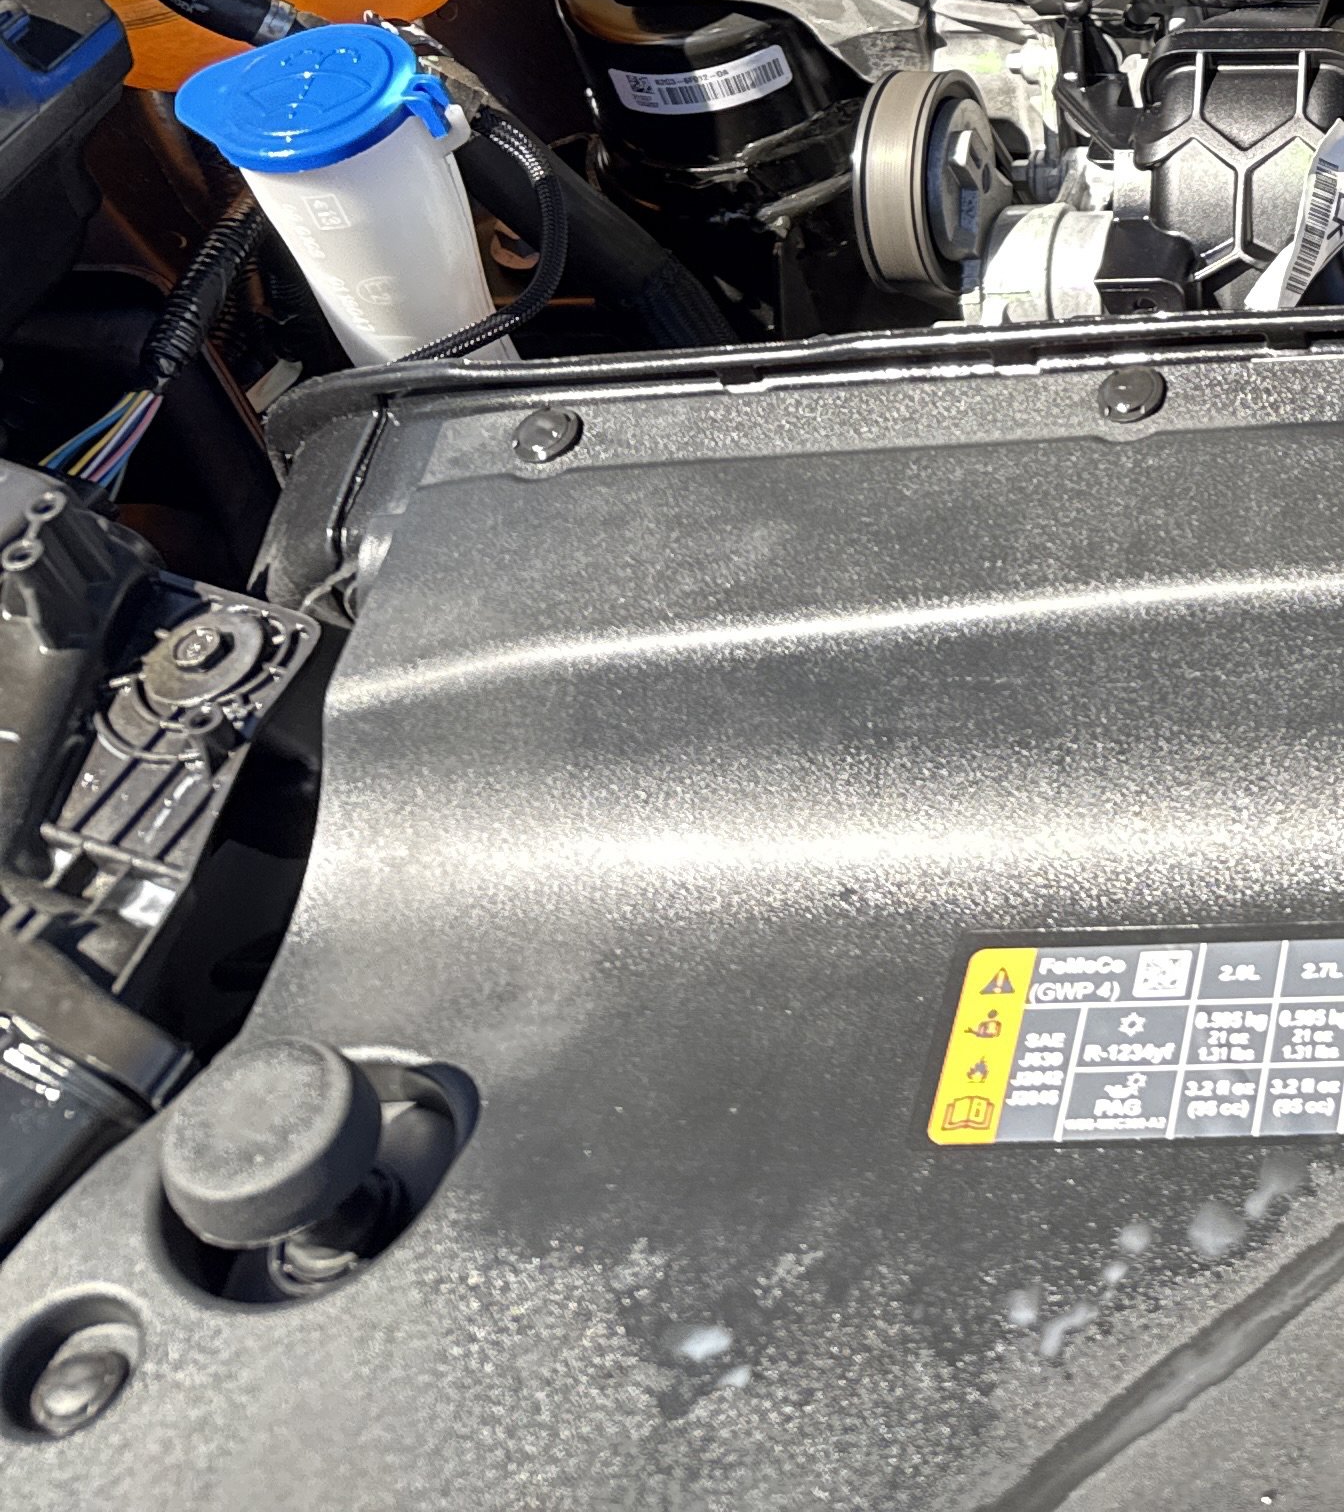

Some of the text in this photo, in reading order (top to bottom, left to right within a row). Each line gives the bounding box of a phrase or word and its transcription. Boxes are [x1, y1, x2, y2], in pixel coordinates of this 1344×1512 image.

[1038, 955, 1127, 976] FoMoCo
[1300, 961, 1344, 980] 2.7L
[1028, 980, 1121, 1004] (GWP 4)
[1245, 1010, 1269, 1032] kg
[1024, 1032, 1066, 1049] SAE
[1207, 1030, 1251, 1045] 21 oz
[1291, 1028, 1334, 1044] 21 oz
[1082, 1042, 1176, 1064] R-1234yf
[1231, 1082, 1256, 1096] oz
[1316, 1080, 1341, 1094] oz
[1093, 1098, 1142, 1117] PAG
